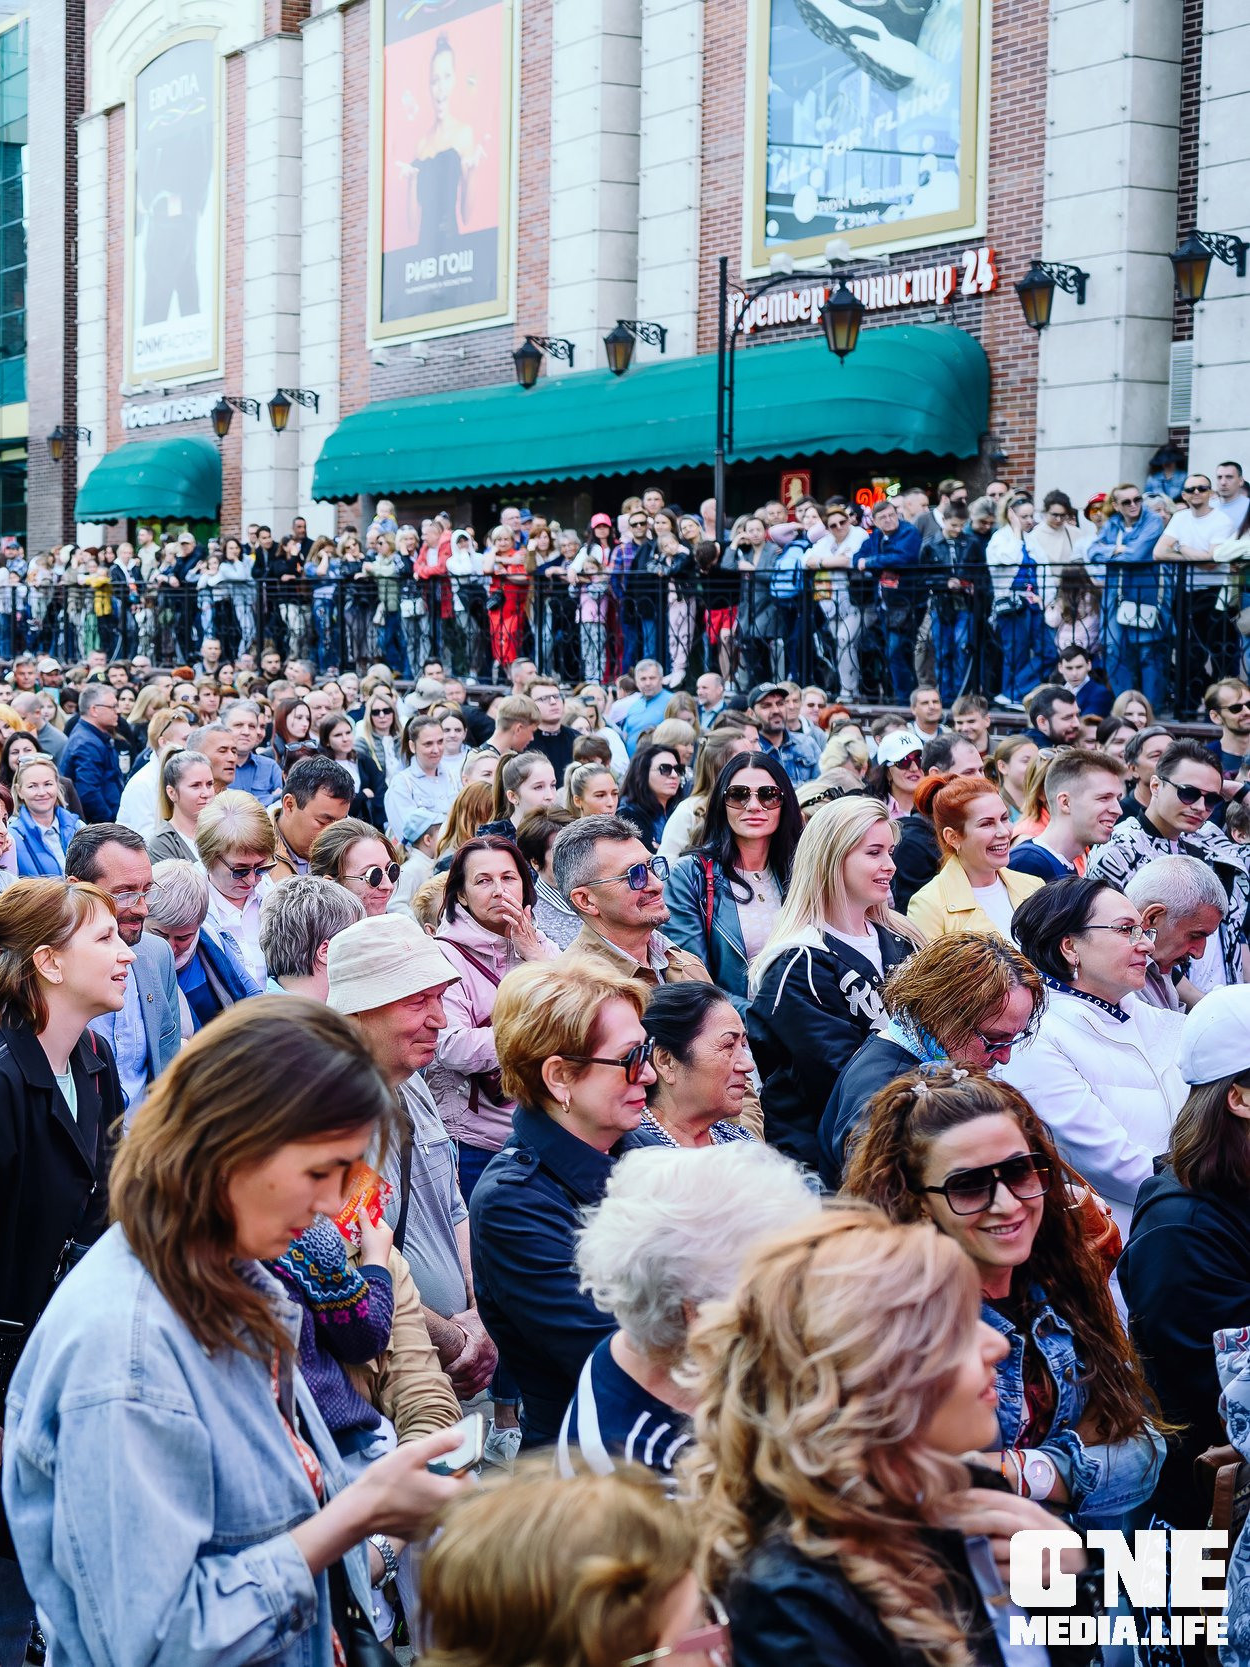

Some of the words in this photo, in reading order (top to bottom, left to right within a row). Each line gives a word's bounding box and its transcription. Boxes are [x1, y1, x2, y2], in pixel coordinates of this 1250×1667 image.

[149, 72, 200, 111] ЕВРОПА
[822, 127, 863, 165] FOR
[873, 82, 952, 138] FLYING
[405, 257, 437, 284] РИВ
[438, 249, 473, 276] ГОШ
[961, 247, 997, 295] 24
[1068, 989, 1124, 1019] LACOSTE
